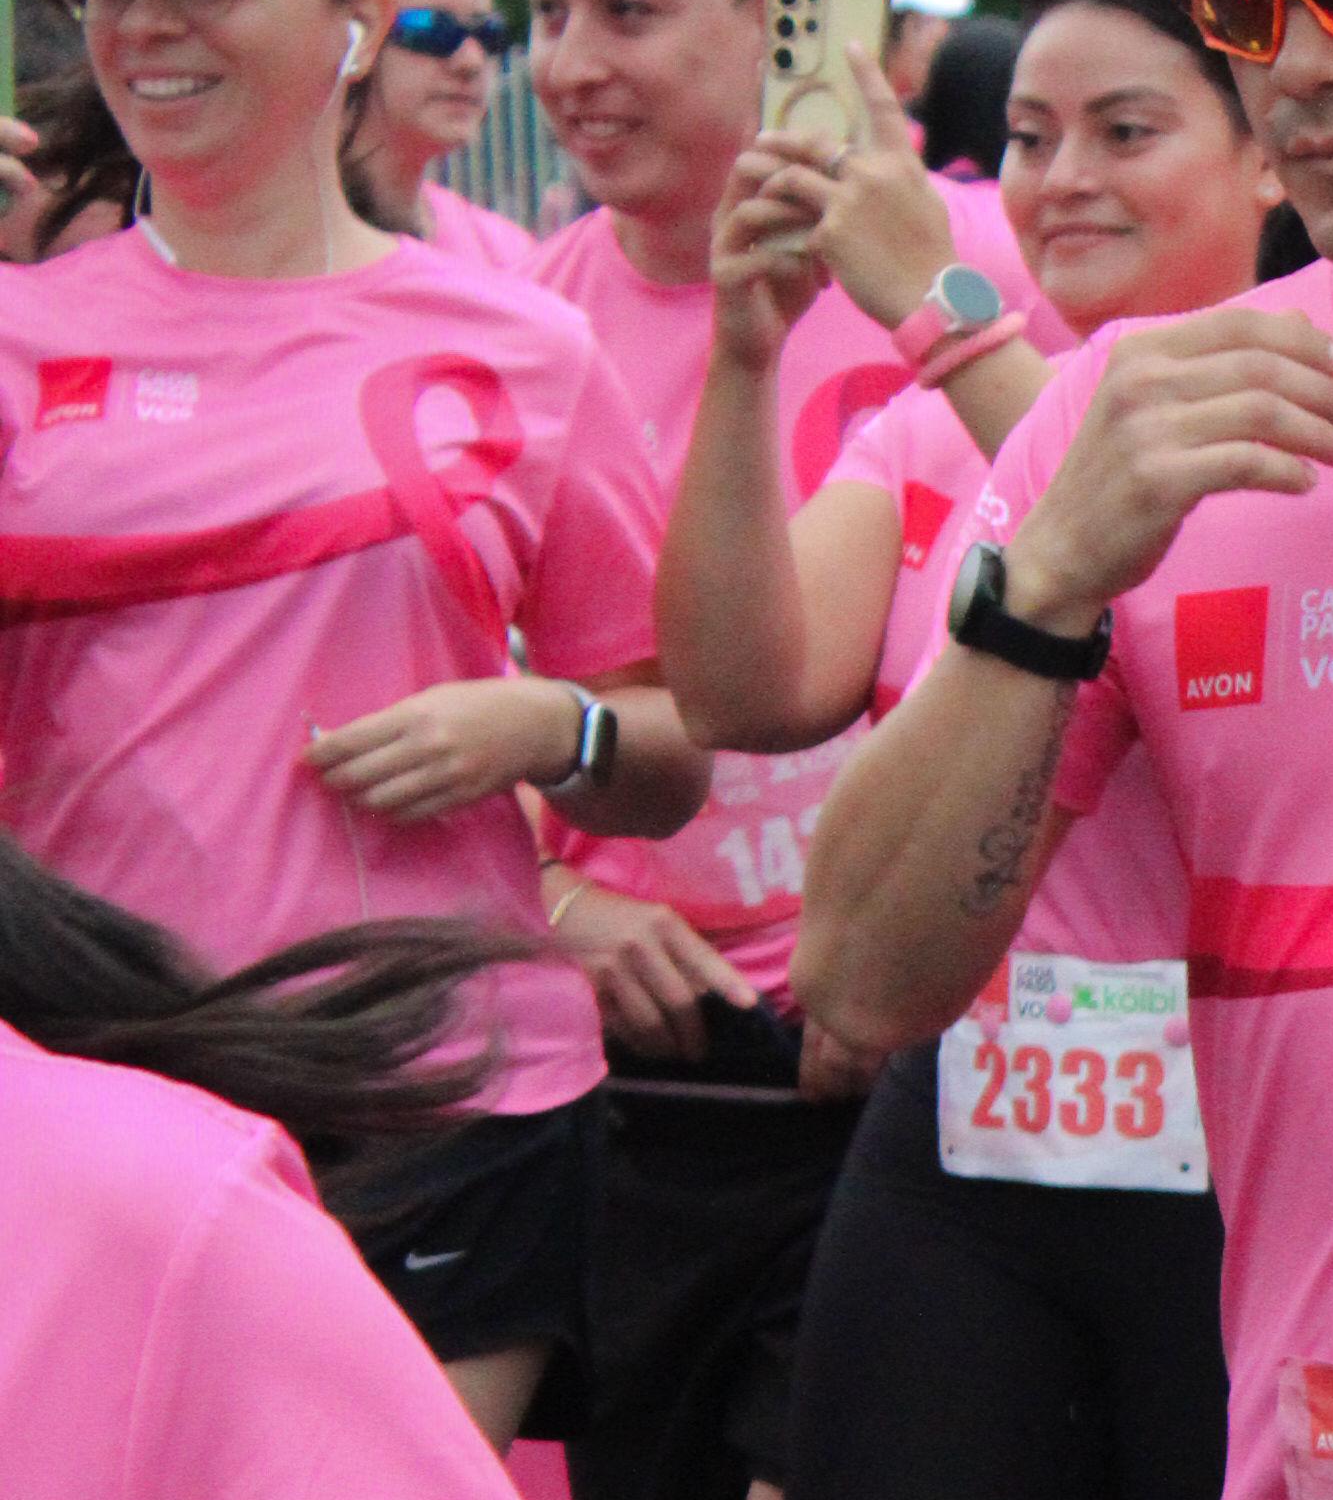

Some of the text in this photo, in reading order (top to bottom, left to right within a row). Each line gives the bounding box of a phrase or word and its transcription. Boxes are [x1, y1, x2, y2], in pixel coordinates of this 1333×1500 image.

[1186, 671, 1254, 699] AVON
[1102, 983, 1178, 1015] kölbi
[970, 1040, 1165, 1141] 2333
